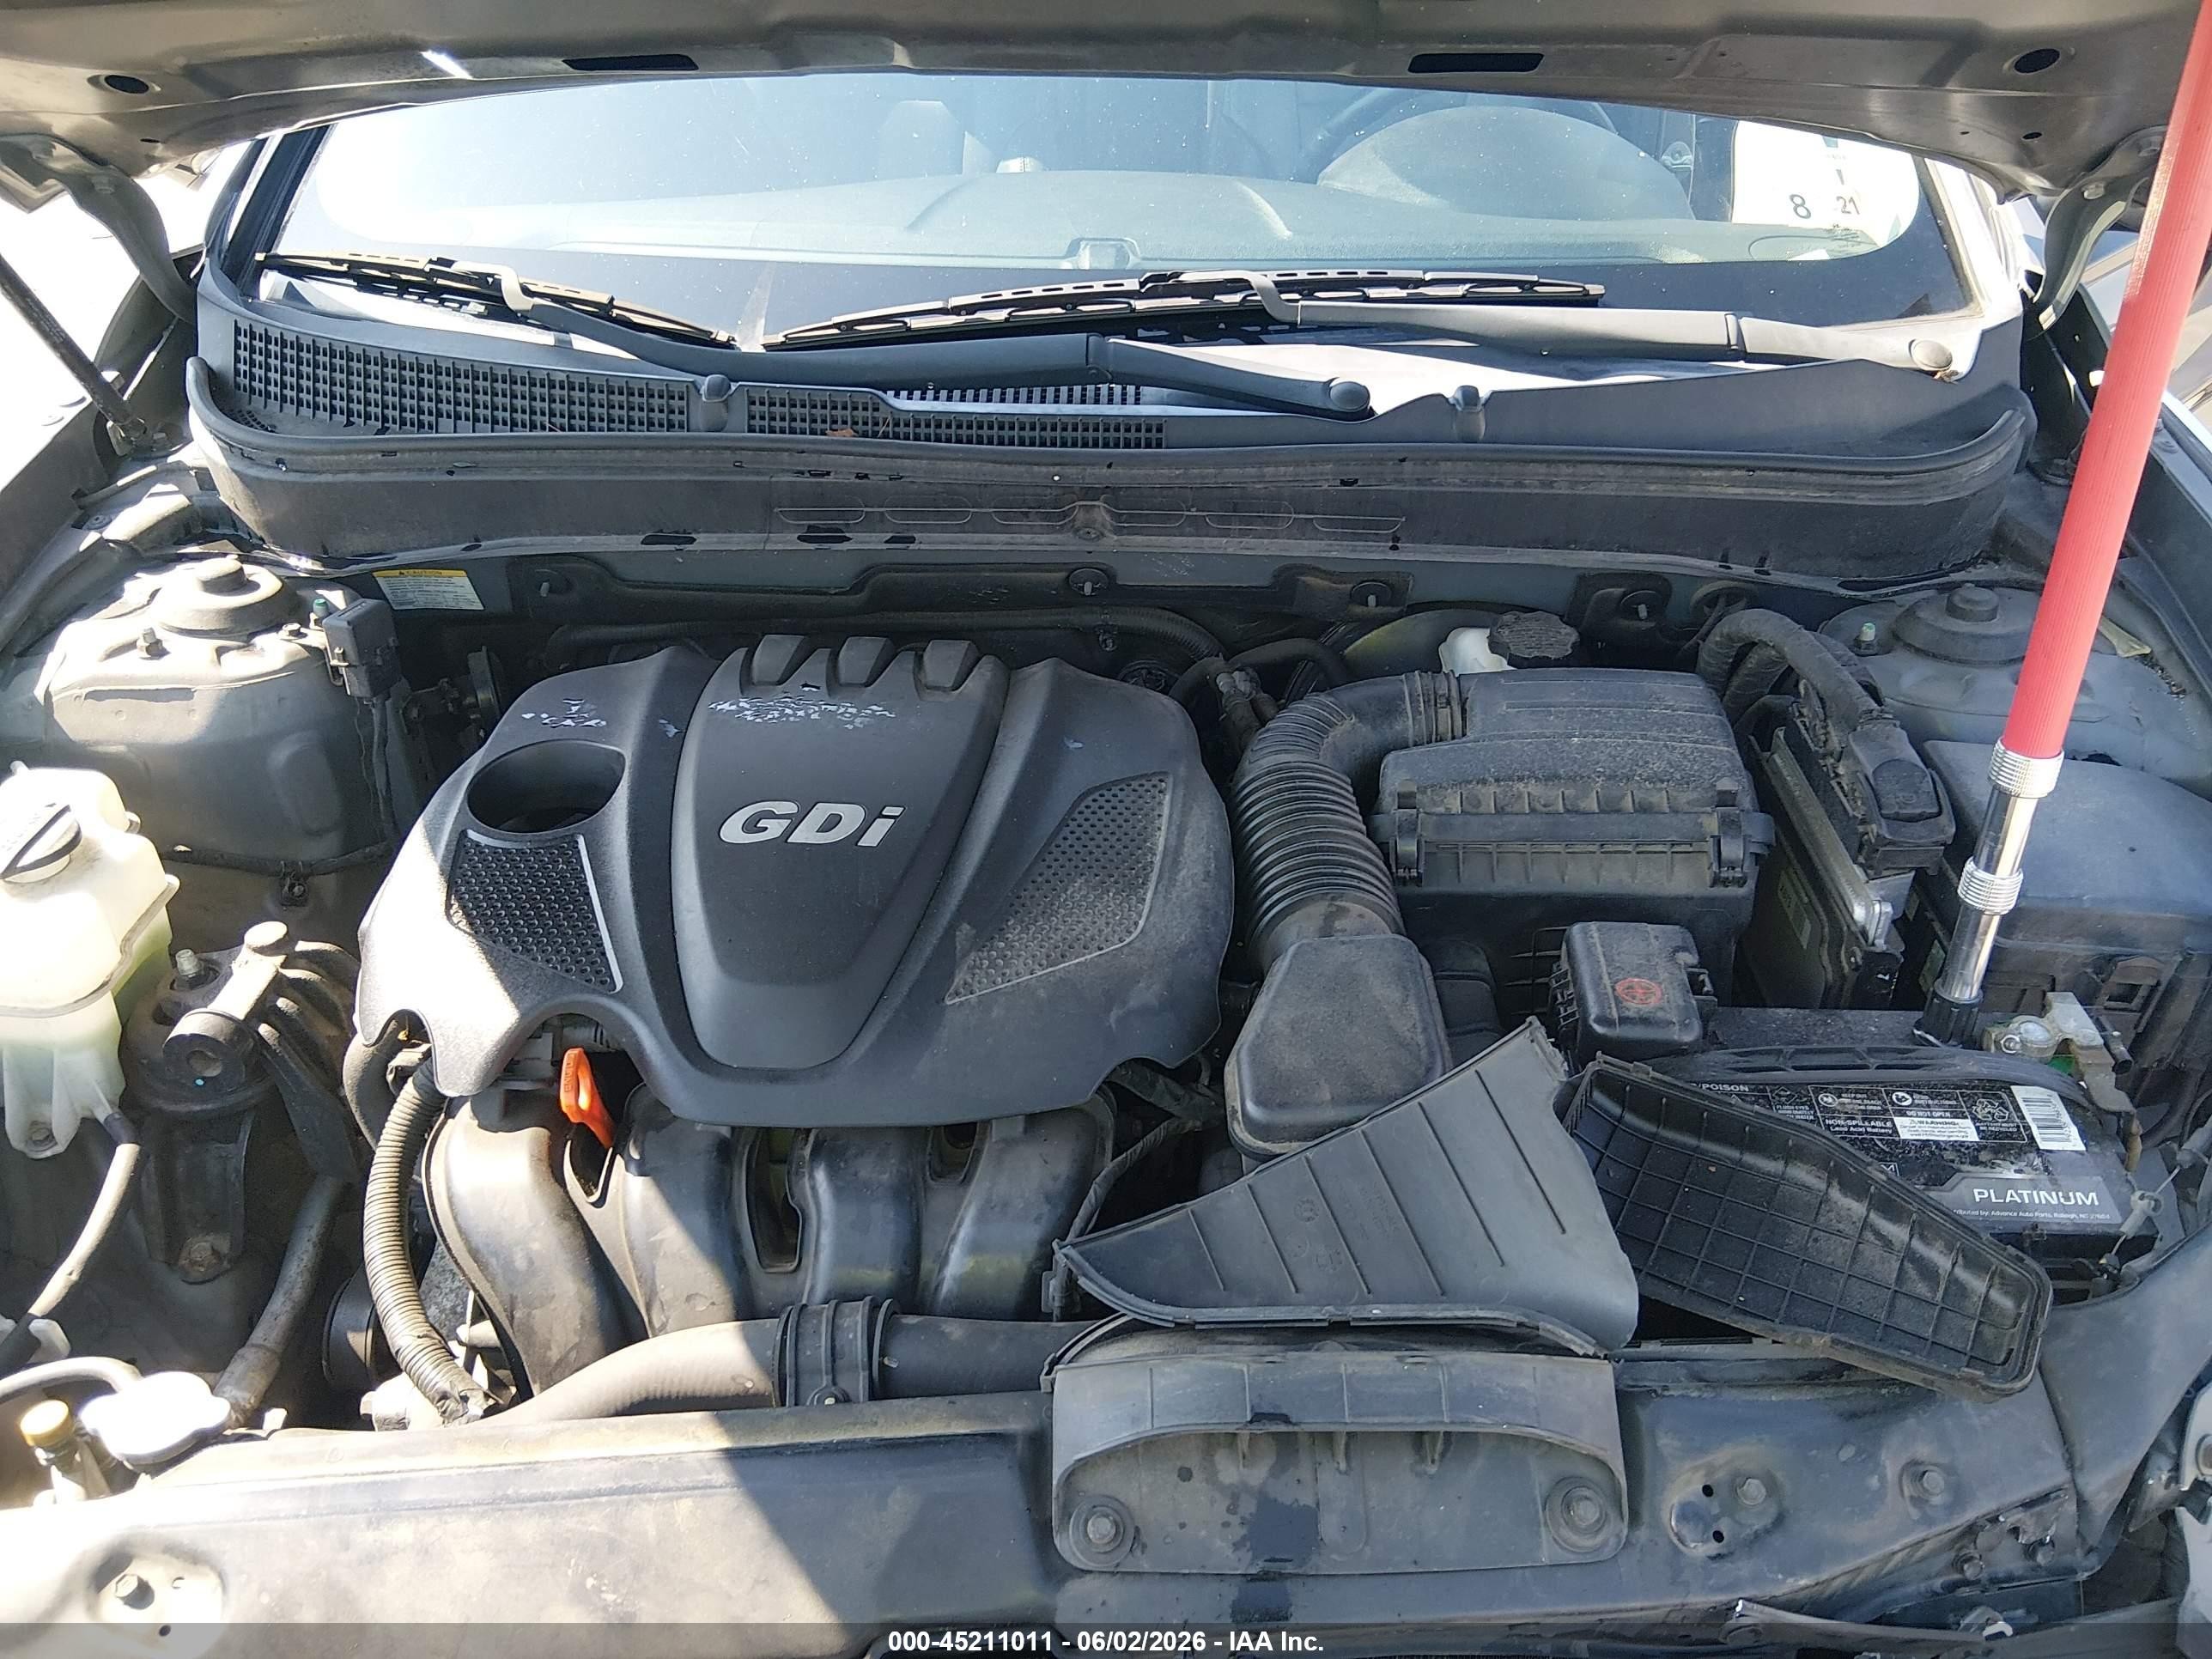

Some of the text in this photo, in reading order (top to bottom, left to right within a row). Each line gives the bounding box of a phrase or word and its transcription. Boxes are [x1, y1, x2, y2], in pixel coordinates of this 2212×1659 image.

[1789, 194, 1812, 219] 8
[719, 800, 905, 848] GDi
[1972, 1188, 2100, 1206] PLATINUM
